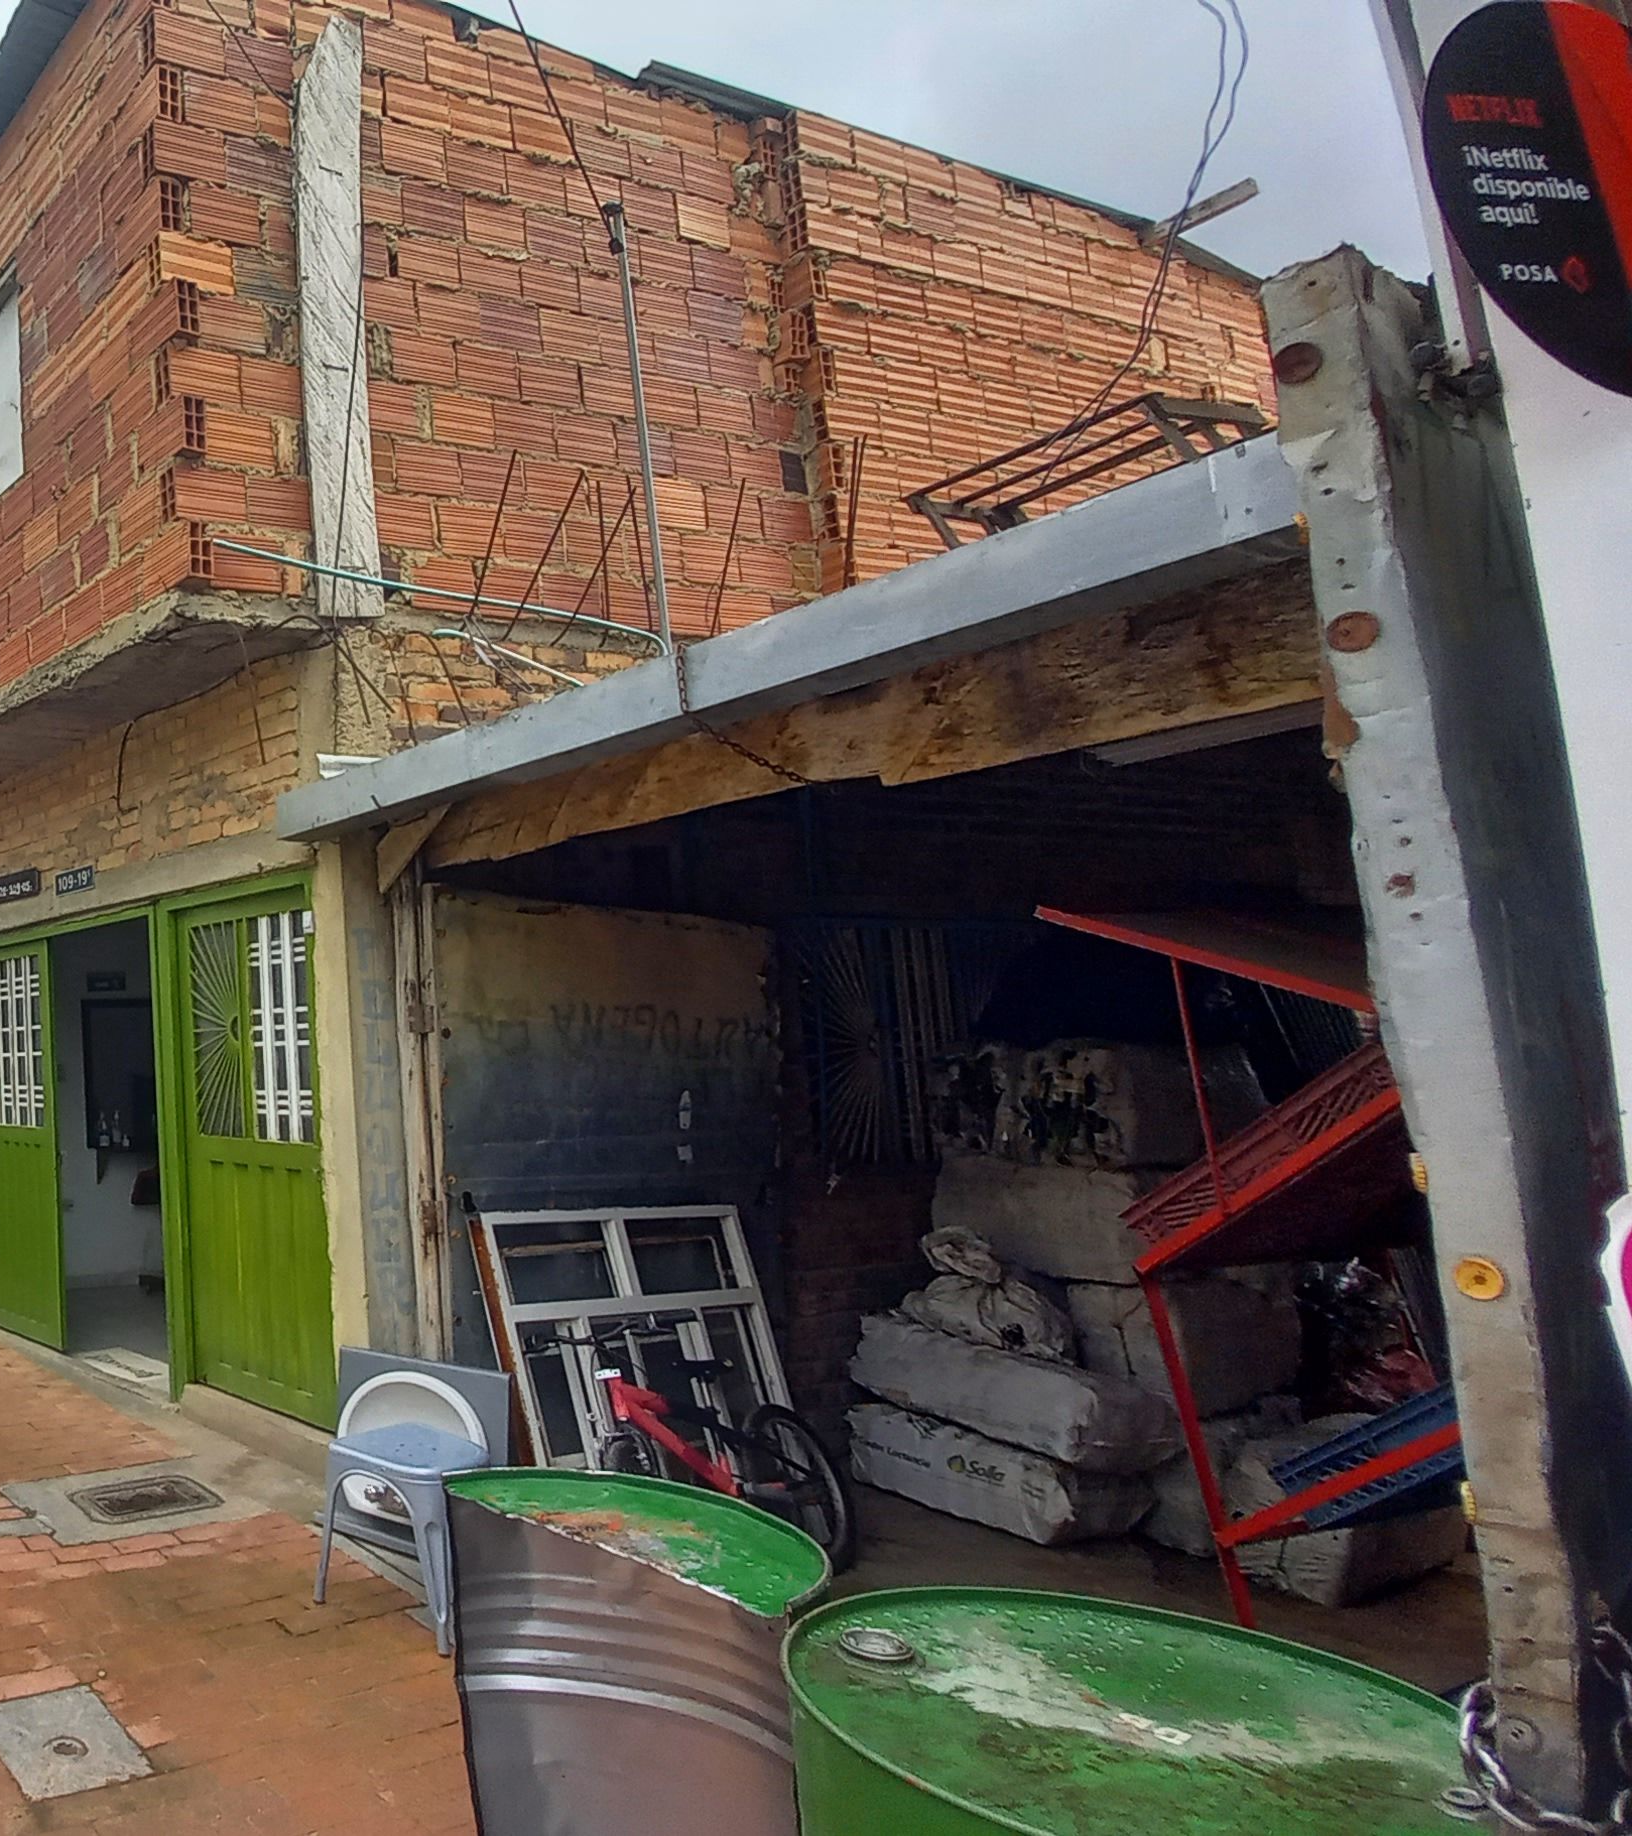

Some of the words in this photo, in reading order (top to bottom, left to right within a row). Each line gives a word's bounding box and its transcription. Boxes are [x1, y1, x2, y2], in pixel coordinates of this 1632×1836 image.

[1445, 94, 1544, 128] NETFLIX
[1472, 173, 1591, 202] disponible
[1499, 262, 1559, 284] POSA
[965, 1460, 1007, 1482] Solla
